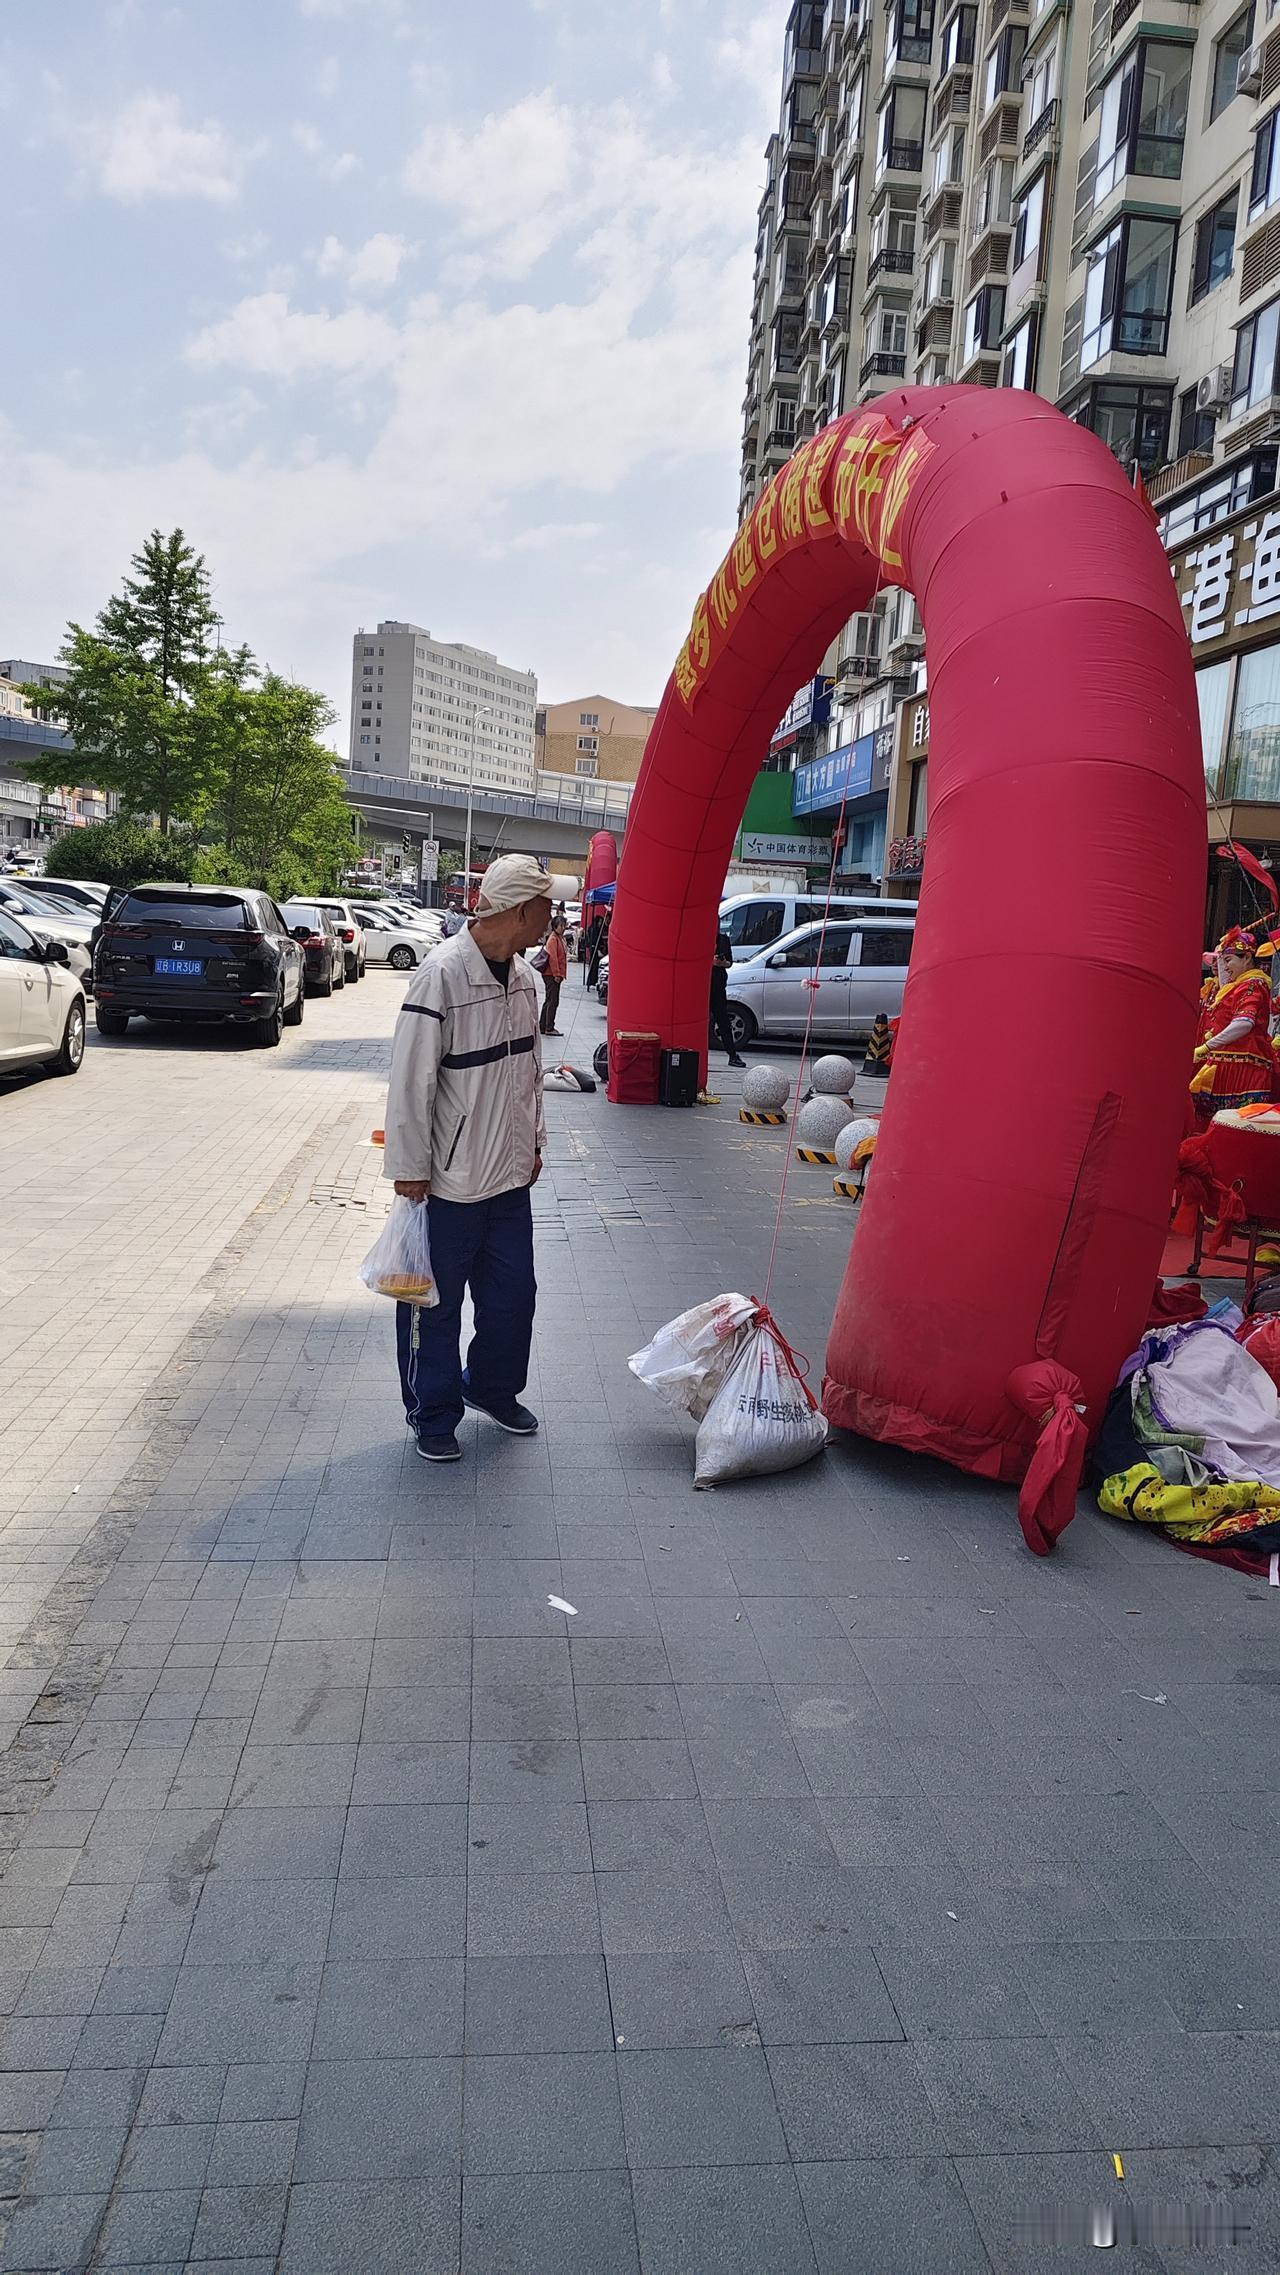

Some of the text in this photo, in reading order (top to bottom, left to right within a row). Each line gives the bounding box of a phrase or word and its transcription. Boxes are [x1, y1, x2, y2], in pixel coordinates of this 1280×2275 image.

[1171, 511, 1280, 643] 港渔
[766, 842, 830, 857] 中国体育彩票
